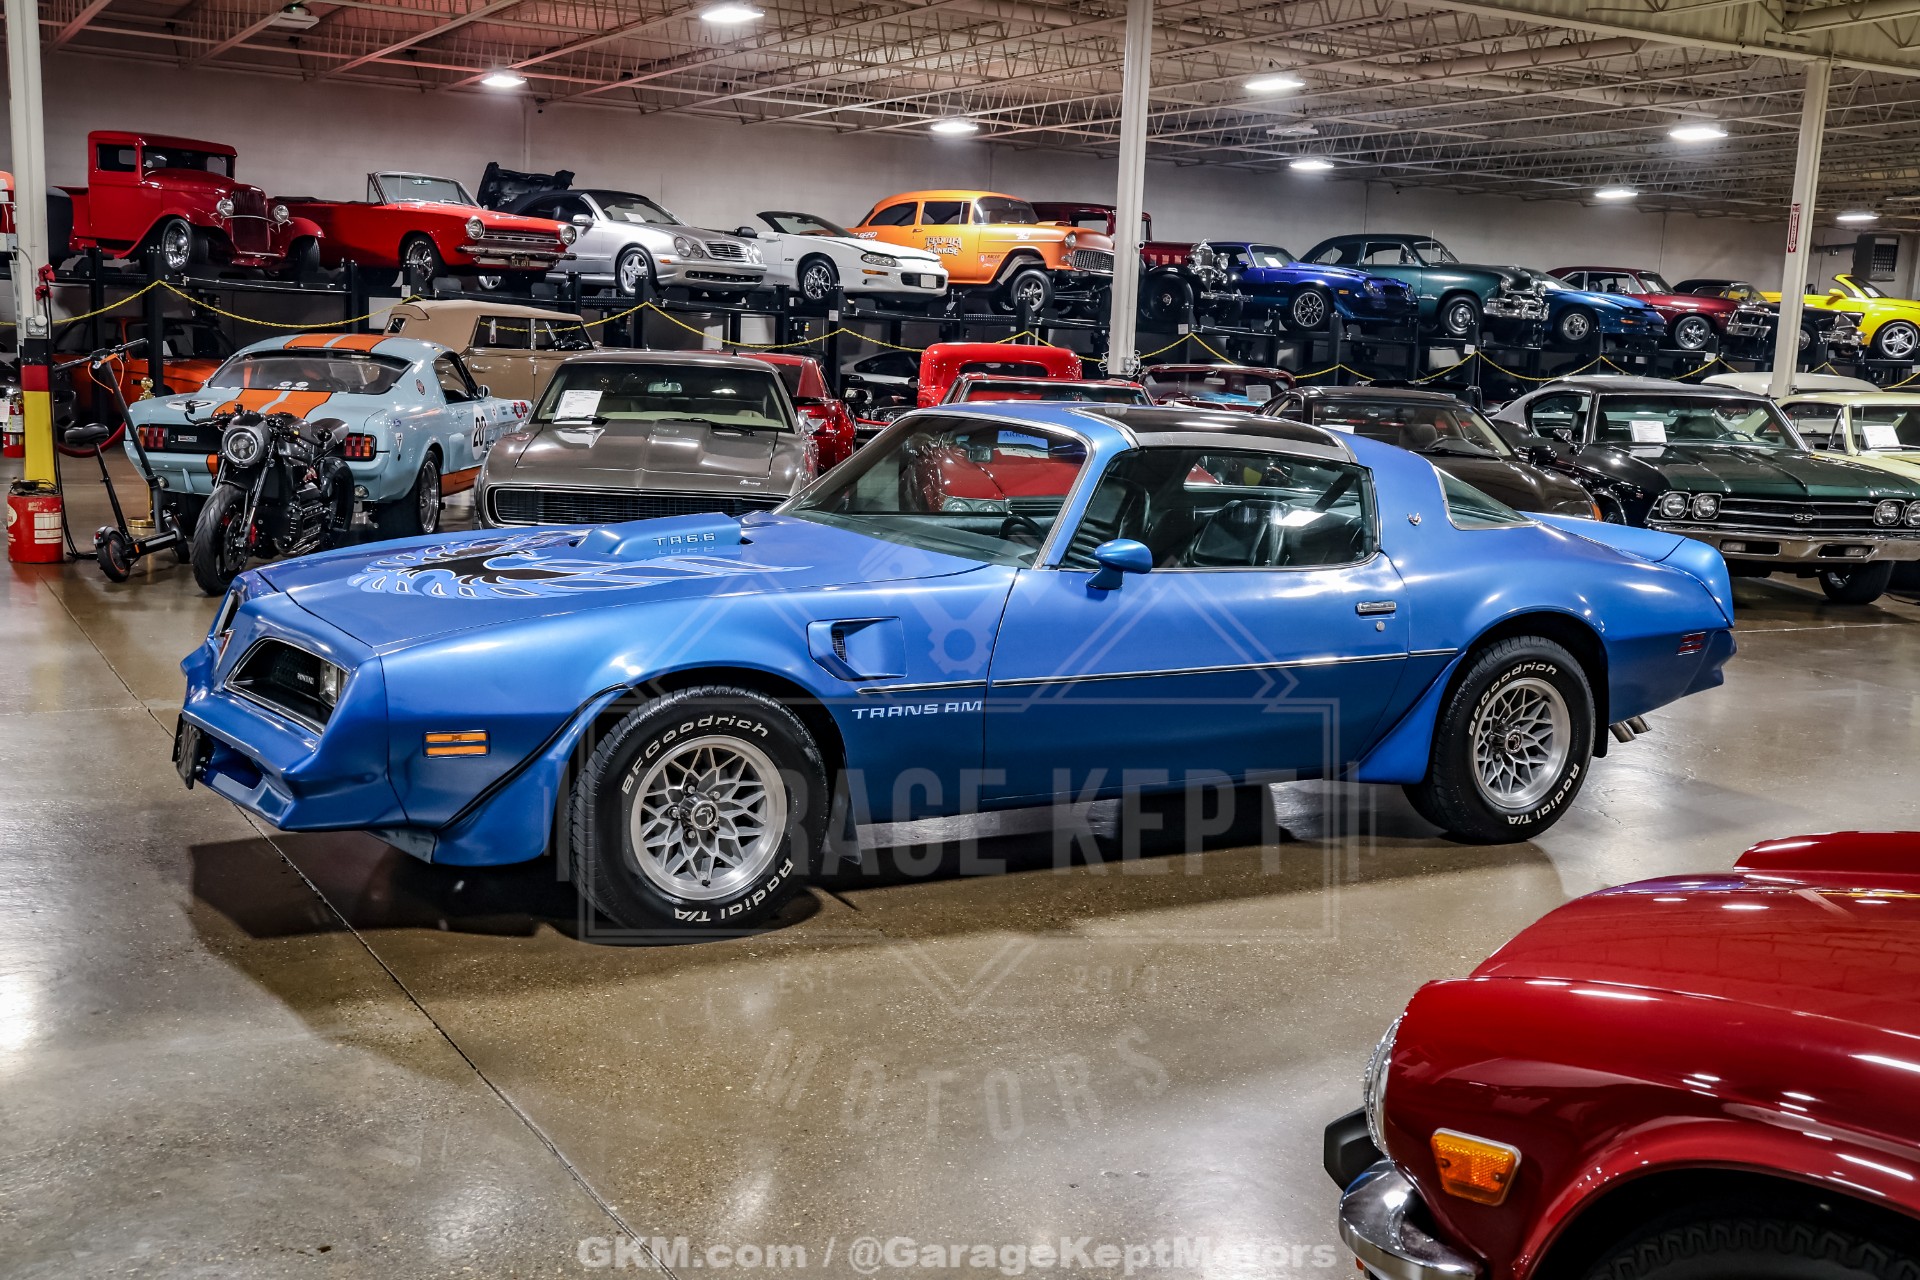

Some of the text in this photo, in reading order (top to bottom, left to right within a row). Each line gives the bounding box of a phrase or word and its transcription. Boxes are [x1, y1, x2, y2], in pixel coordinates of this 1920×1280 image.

[473, 415, 487, 448] 20
[851, 700, 983, 720] TRANS AM
[1468, 661, 1557, 737] BFGoodrich
[621, 714, 769, 795] BFGoodrich
[1536, 762, 1580, 820] Radial
[673, 907, 712, 922] T/A
[719, 857, 794, 920] Radial
